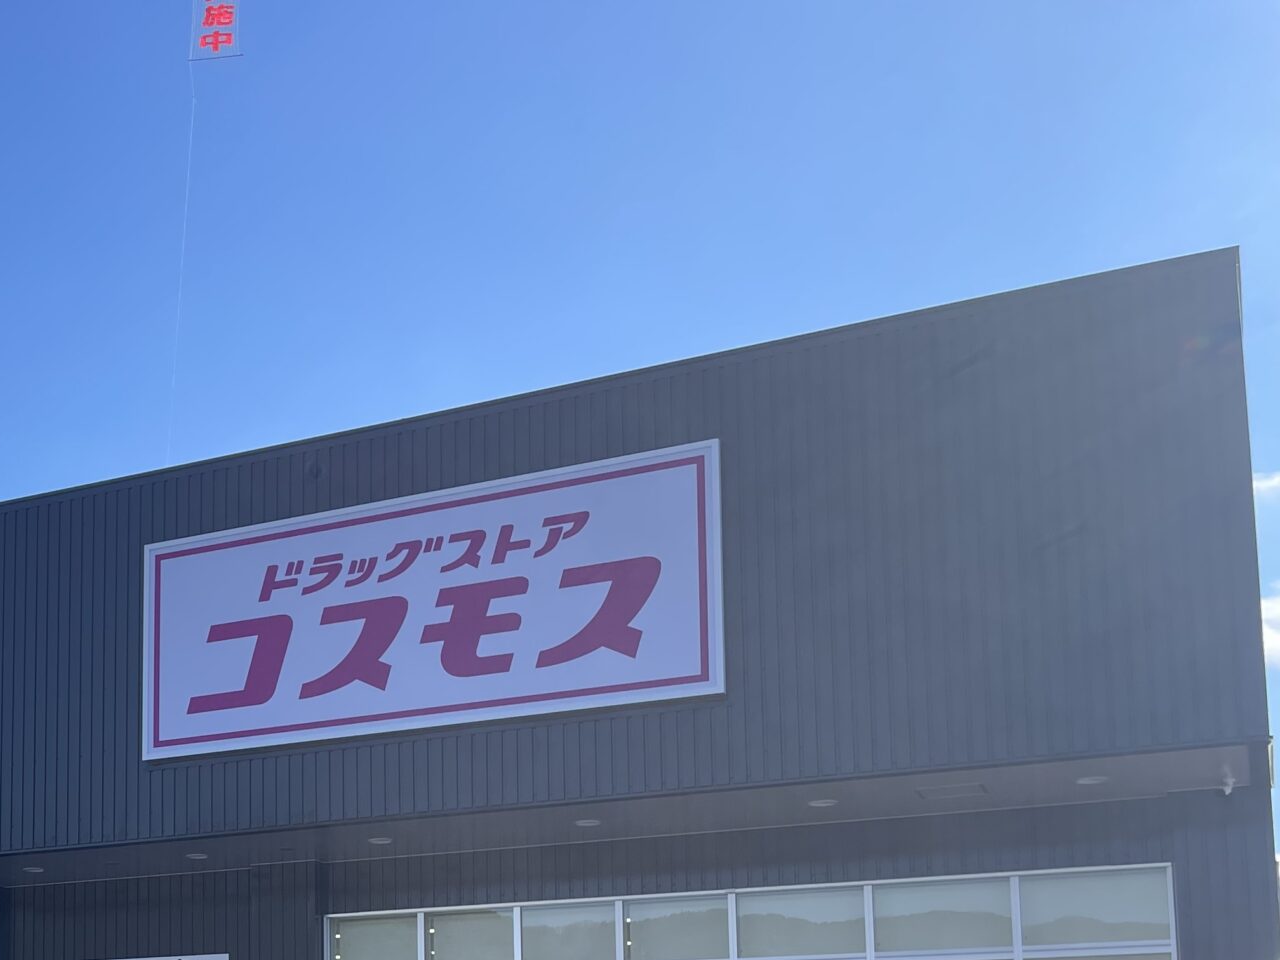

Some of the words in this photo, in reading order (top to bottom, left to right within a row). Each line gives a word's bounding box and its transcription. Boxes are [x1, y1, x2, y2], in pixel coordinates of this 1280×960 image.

[200, 0, 234, 52] 施中
[258, 511, 590, 602] ドラッグストア
[187, 556, 662, 714] コスモス
